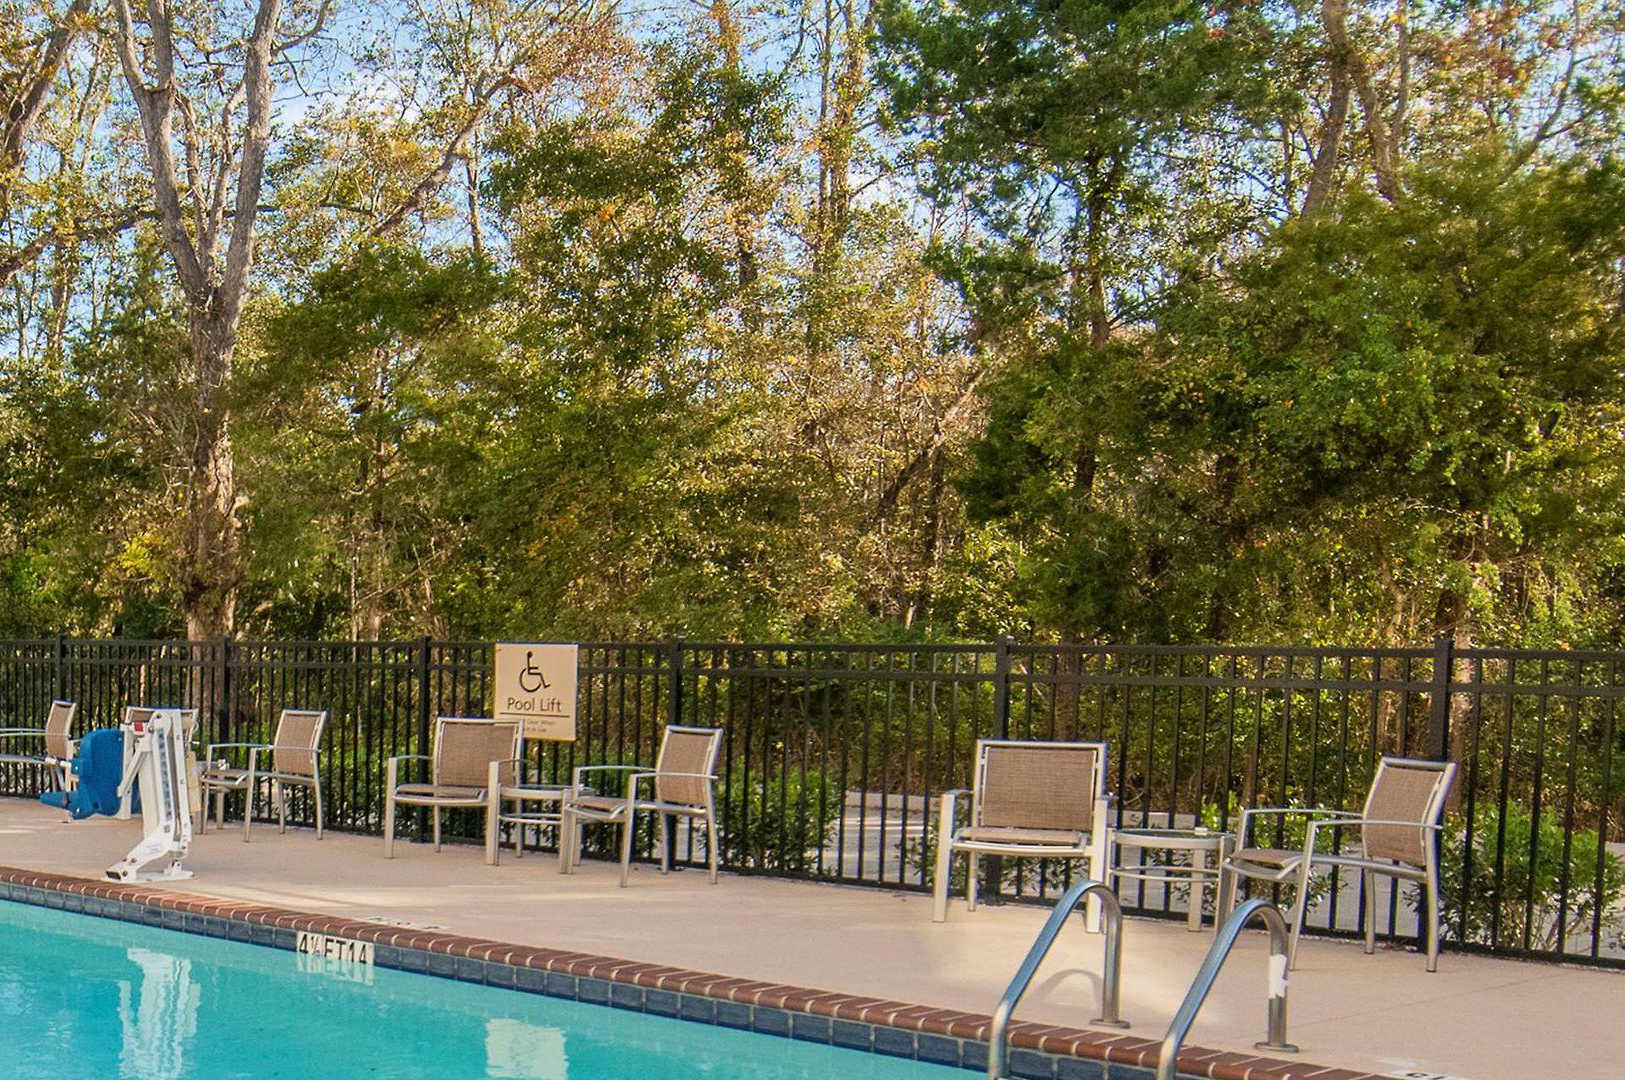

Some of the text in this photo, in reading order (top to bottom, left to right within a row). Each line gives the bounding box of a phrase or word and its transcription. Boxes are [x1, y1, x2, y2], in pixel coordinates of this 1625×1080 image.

[507, 697, 562, 712] Pool Lift
[324, 938, 346, 960] FT
